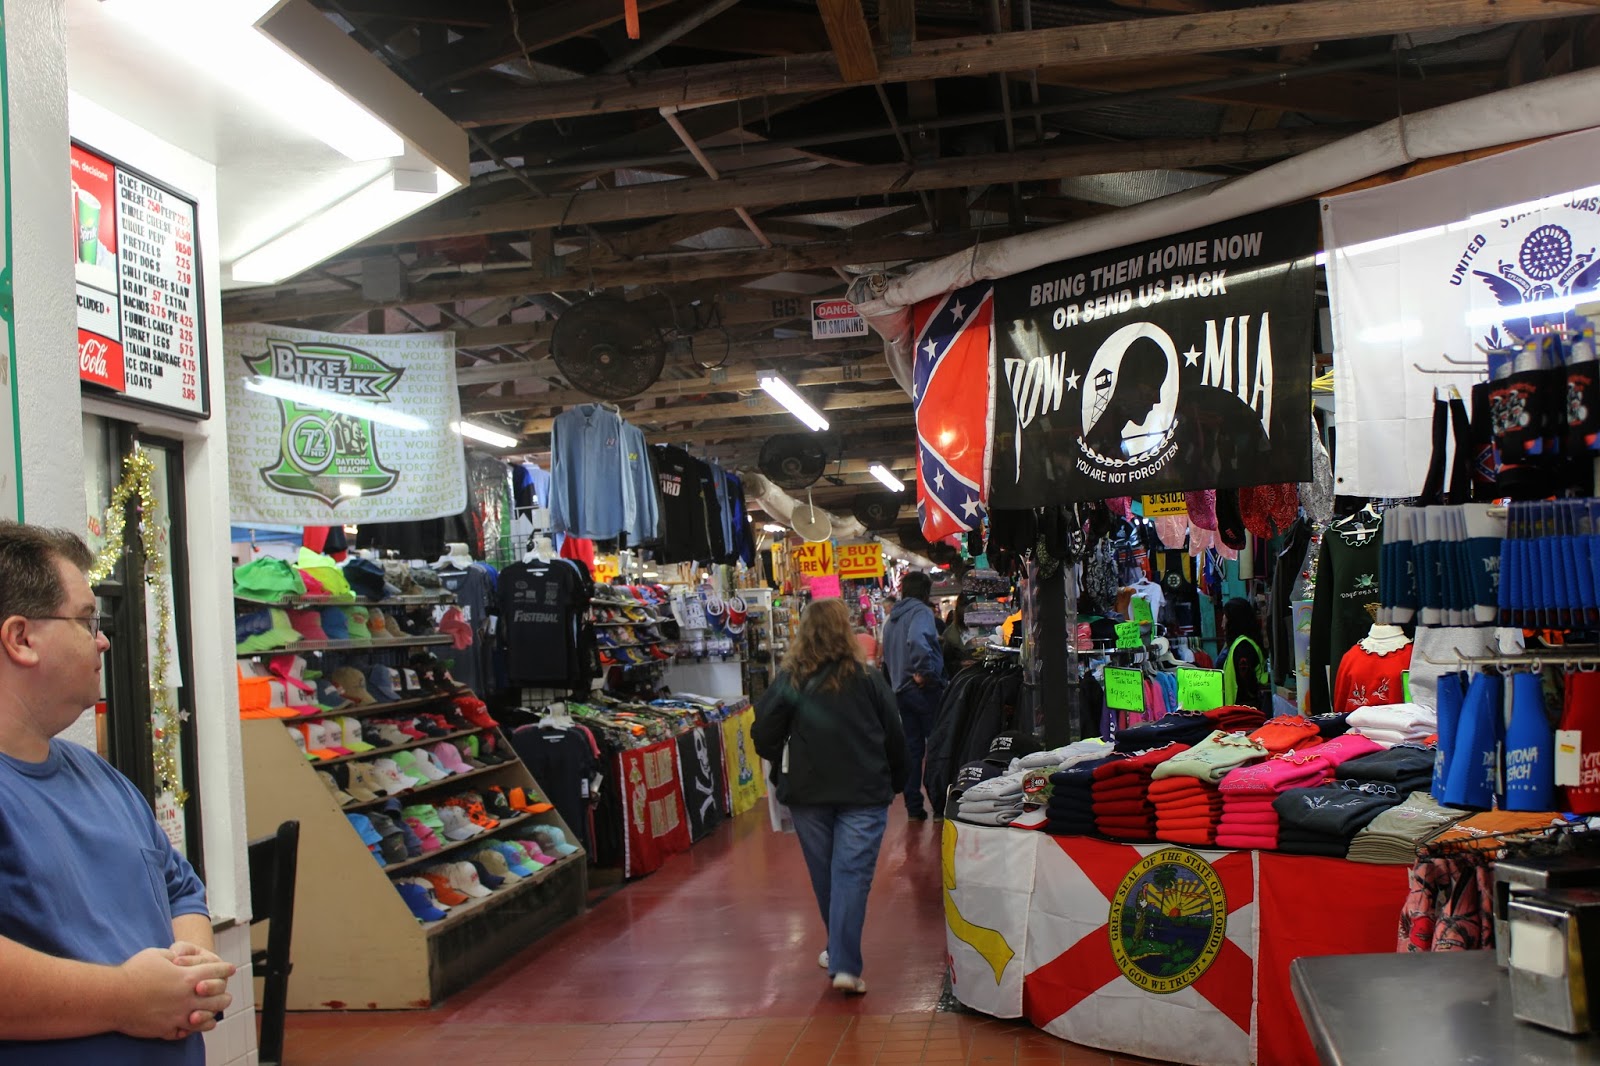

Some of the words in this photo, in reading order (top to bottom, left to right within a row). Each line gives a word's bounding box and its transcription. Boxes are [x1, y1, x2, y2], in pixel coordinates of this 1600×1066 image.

[82, 162, 108, 181] decisions
[118, 173, 138, 191] SLICE
[141, 184, 163, 204] PIZZA
[121, 187, 145, 207] CHEESE
[122, 218, 144, 237] WHOLE
[124, 234, 161, 258] PRETZELS
[122, 248, 137, 264] HOT
[140, 255, 160, 272] DOGS
[1030, 273, 1086, 307] BRING
[1091, 256, 1143, 289] THEM
[1148, 240, 1207, 275] HOME
[1213, 232, 1263, 264] NOW
[1450, 234, 1487, 286] UNITED
[1562, 264, 1580, 280] UNUM
[122, 264, 140, 280] CHILI
[143, 272, 168, 290] CHEESE
[170, 282, 190, 298] SLAW
[76, 294, 104, 314] NCLUDED
[123, 279, 148, 298] KRAUT
[165, 294, 186, 312] EXTRA
[1053, 307, 1079, 330] OR
[1083, 288, 1133, 323] SEND
[1138, 280, 1165, 308] US
[1170, 270, 1227, 300] BACK
[123, 294, 150, 314] NACHOS
[168, 310, 178, 324] PIE
[124, 310, 152, 329] FUNNEL
[153, 319, 174, 336] CAKES
[816, 320, 827, 335] NO
[830, 318, 864, 334] SMOKING
[124, 325, 150, 343] TURKEY
[153, 334, 170, 350] LEGS
[126, 341, 150, 358] ITALIAN
[153, 349, 181, 368] SAUSAGE
[126, 356, 137, 371] ICE
[140, 360, 164, 377] CREAM
[276, 348, 342, 378] BIKE
[126, 372, 152, 390] FLOATS
[294, 373, 372, 395] WEEK
[1200, 312, 1273, 440] MIA
[1004, 351, 1067, 484] POW
[300, 428, 326, 456] 72
[335, 458, 371, 466] DAYTONA
[338, 466, 363, 474] BEACH
[1076, 458, 1092, 474] YOU
[1090, 468, 1107, 482] ARE
[1108, 472, 1126, 483] NOT
[1128, 442, 1179, 482] FORGOTTEN
[660, 480, 681, 497] ARD
[839, 556, 877, 568] OLD
[848, 545, 878, 556] BUY
[799, 561, 818, 572] ERE
[1142, 856, 1156, 870] OF
[1160, 852, 1182, 862] THE
[1184, 856, 1214, 882] STATE
[1119, 870, 1140, 898] SEAL
[1211, 881, 1222, 897] OF
[1112, 901, 1122, 941] GREAT
[1206, 900, 1224, 956] FLORIDA
[1118, 954, 1128, 969] IN
[1128, 967, 1148, 985] GOD
[1152, 980, 1166, 990] WE
[1168, 964, 1202, 988] TRUST
